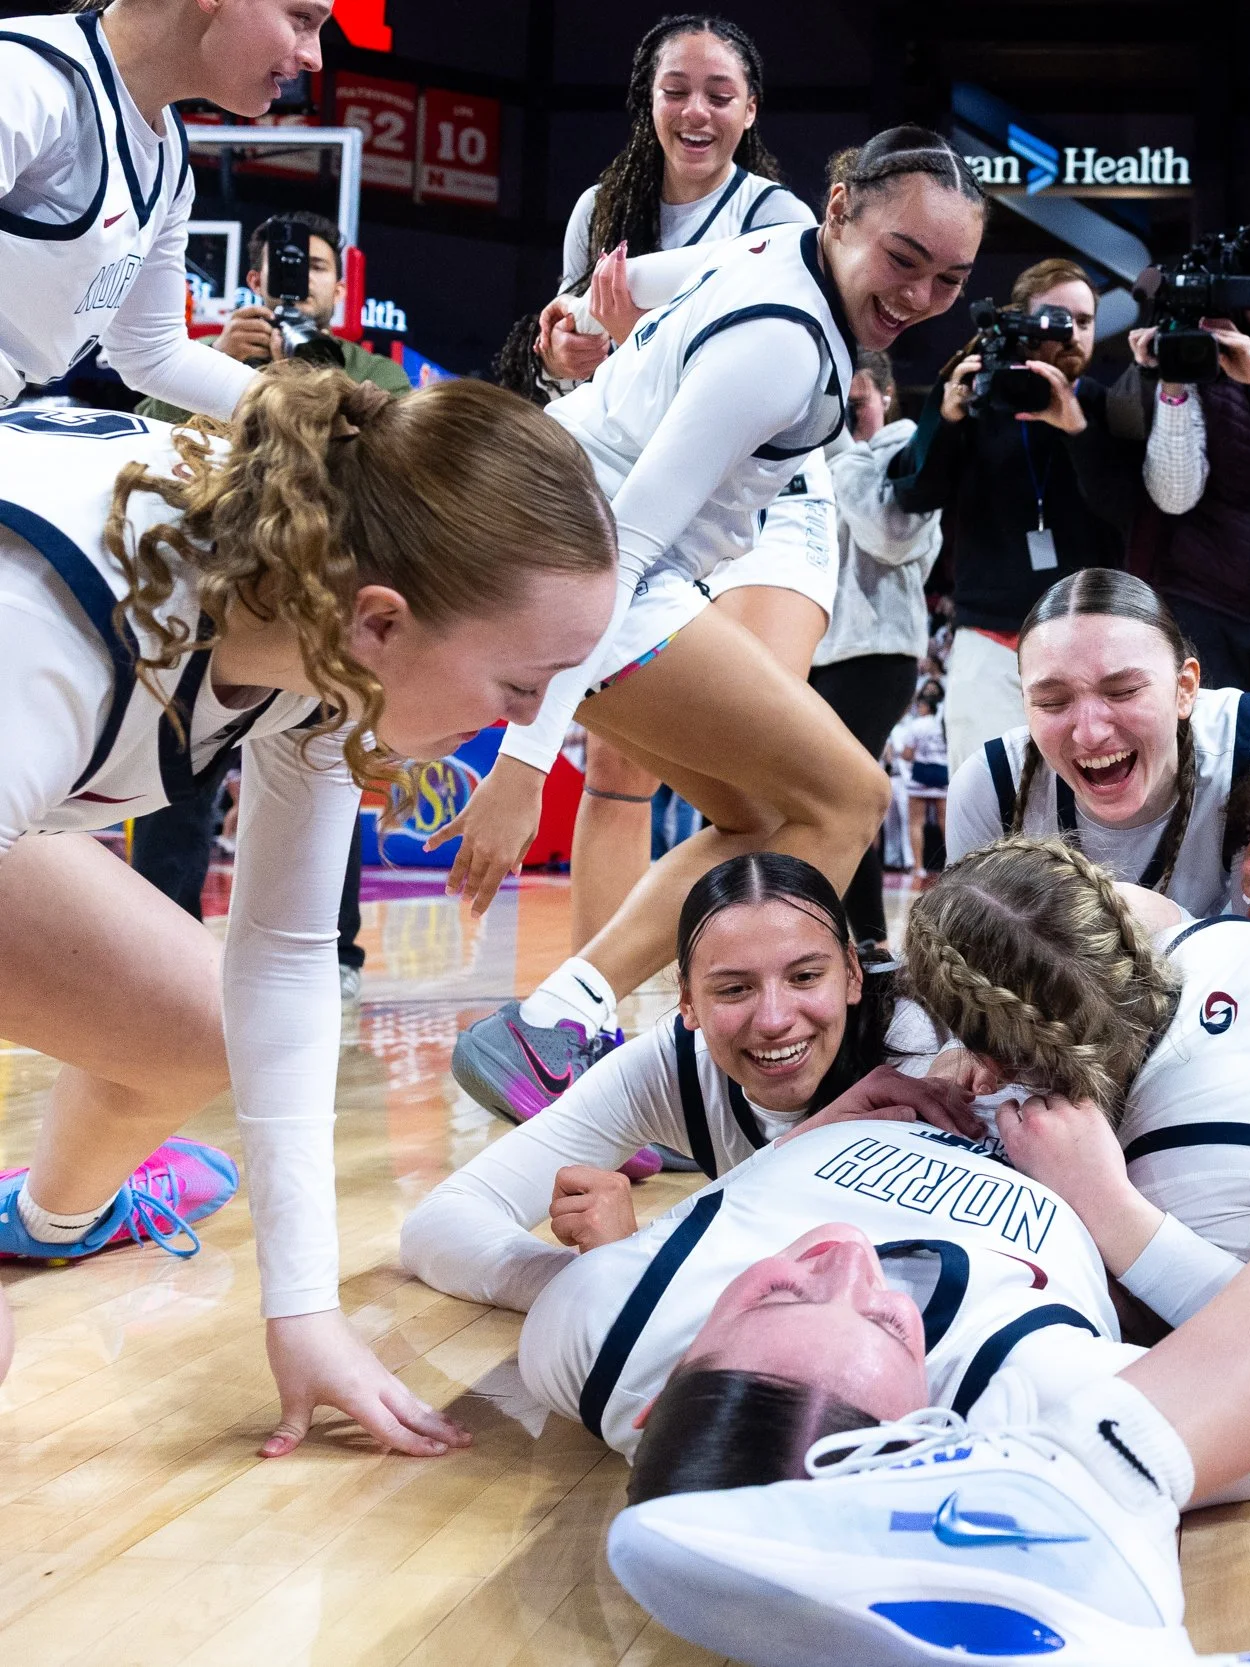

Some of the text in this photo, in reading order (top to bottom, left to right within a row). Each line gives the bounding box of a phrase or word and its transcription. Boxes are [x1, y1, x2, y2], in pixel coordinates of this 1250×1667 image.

[343, 104, 407, 152] 52
[437, 121, 487, 165] 10
[1063, 145, 1191, 185] Health
[74, 254, 142, 314] NOR
[814, 1137, 1057, 1254] NORTH
